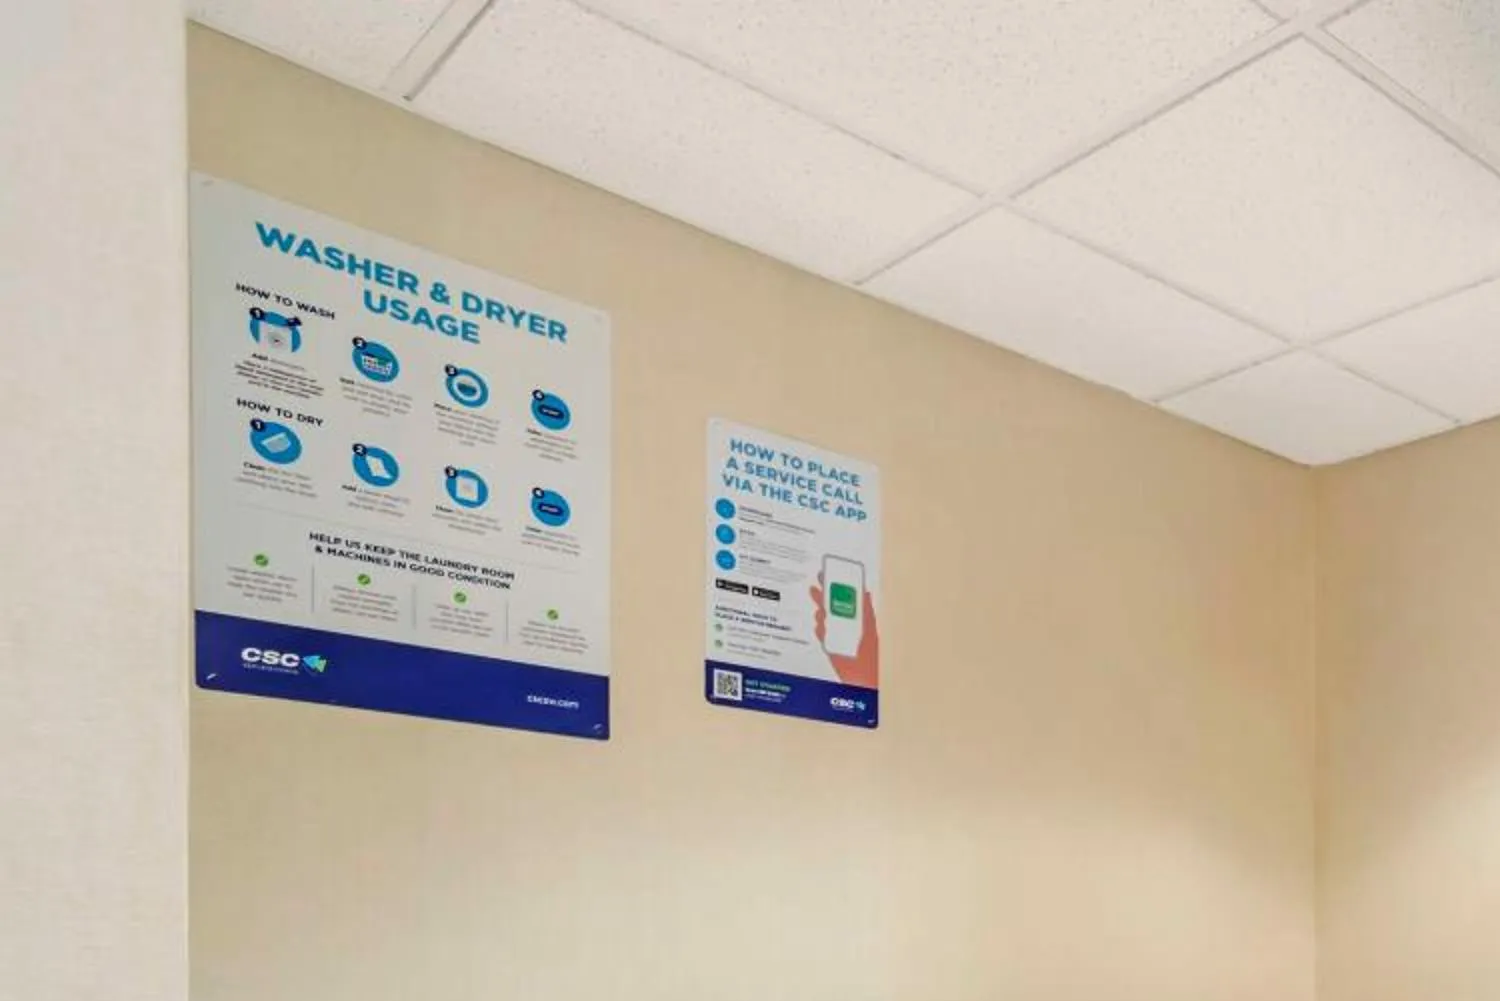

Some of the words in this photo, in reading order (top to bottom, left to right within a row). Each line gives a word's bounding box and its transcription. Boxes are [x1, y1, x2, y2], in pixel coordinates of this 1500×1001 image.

[235, 283, 271, 302] HOW
[275, 293, 293, 307] TO
[296, 299, 336, 321] WASH
[255, 221, 420, 295] WASHER
[430, 282, 451, 304] &
[461, 291, 568, 344] DRYER
[364, 289, 481, 345] USAGE
[236, 397, 271, 416] HOW
[274, 406, 294, 420] TO
[297, 411, 325, 428] DRY
[725, 456, 740, 472] A
[744, 461, 817, 493] SERVICE
[822, 483, 864, 505] CALL
[729, 438, 775, 463] HOW
[780, 452, 804, 471] TO
[808, 459, 862, 487] PLACE
[722, 473, 754, 494] VIA
[759, 483, 793, 504] THE
[797, 494, 831, 513] CSC
[835, 504, 868, 523] APP
[309, 531, 342, 545] HELP
[345, 538, 361, 550] US
[365, 542, 397, 556] KEEP
[399, 550, 421, 562] THE
[424, 555, 479, 573] LAUNDRY
[481, 566, 515, 580] ROOM
[314, 545, 323, 554] &
[327, 547, 390, 567] MACHINES
[393, 560, 406, 569] IN
[409, 563, 445, 577] GOOD
[447, 571, 511, 590] CONDITION
[241, 647, 300, 668] CSC
